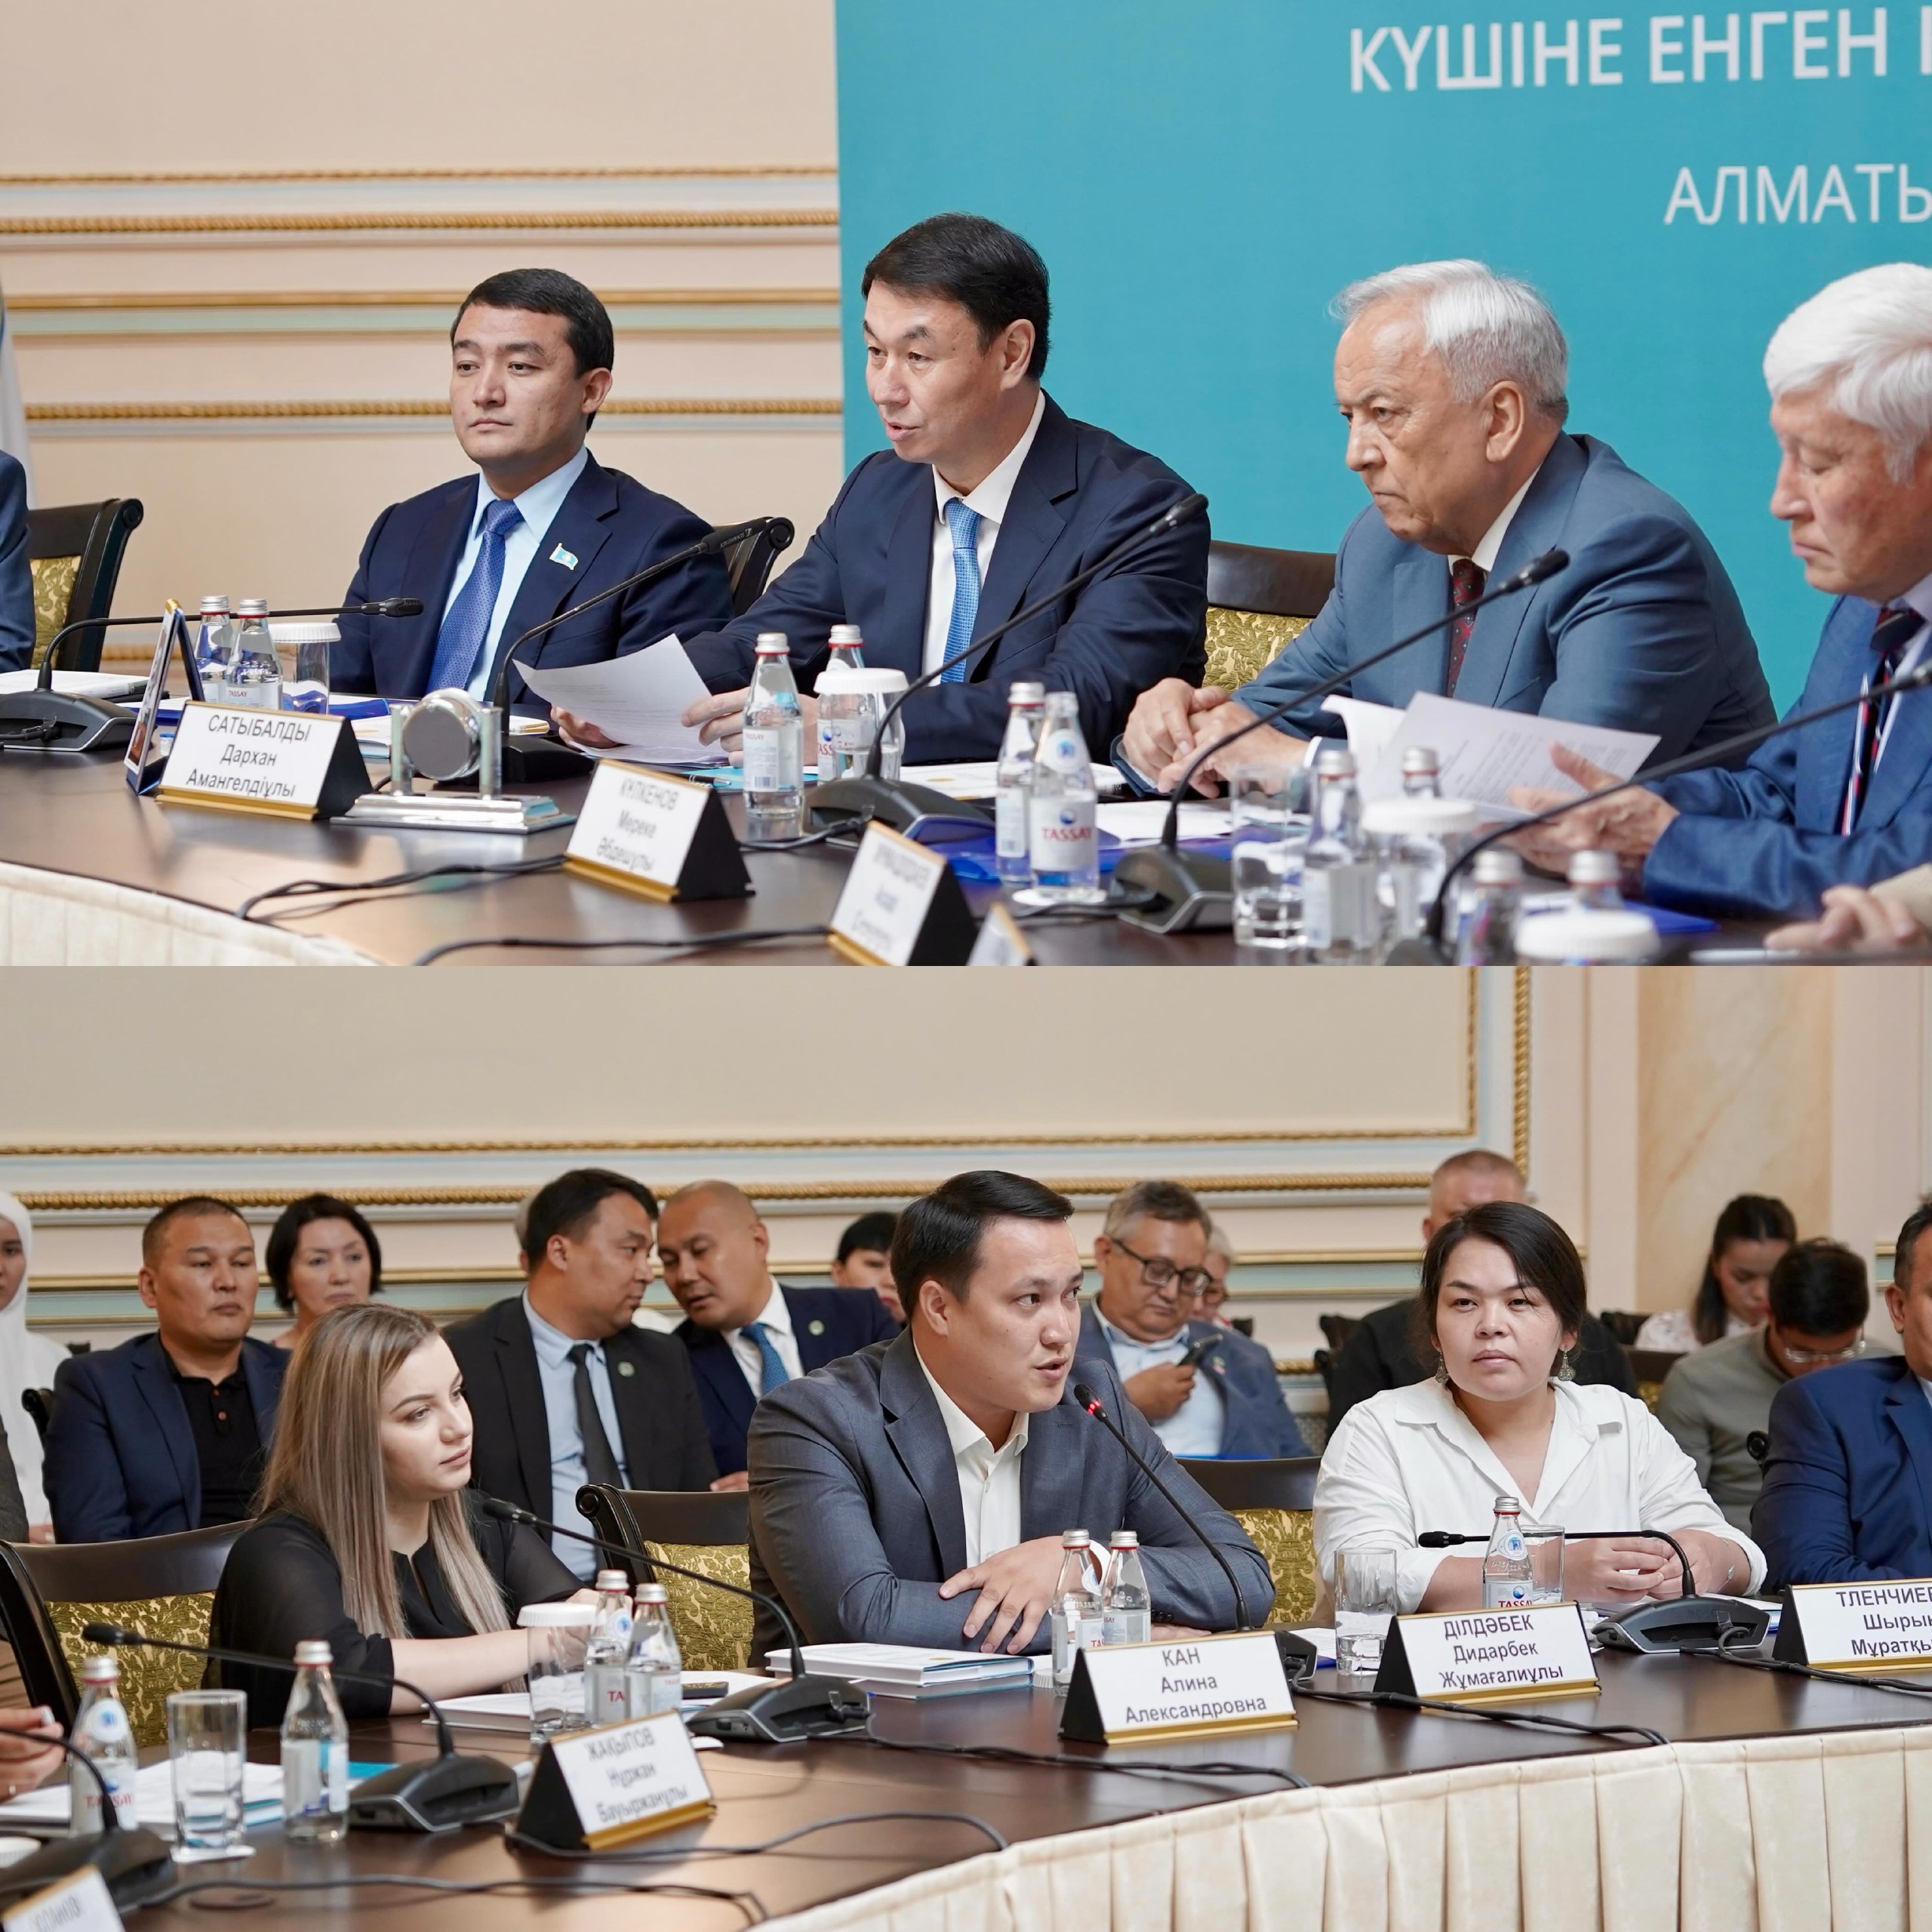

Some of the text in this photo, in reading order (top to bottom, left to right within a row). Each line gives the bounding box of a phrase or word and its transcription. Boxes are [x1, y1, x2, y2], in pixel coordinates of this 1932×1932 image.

[1351, 18, 1623, 92] КҮШІНЕ
[1651, 8, 1887, 83] ЕНГЕН
[208, 714, 312, 743] САТЫБАЛДЫ
[220, 743, 277, 767] Дархан
[186, 768, 297, 798] Амангелдіұлы
[1444, 1614, 1534, 1641] ДІЛДӘБЕК
[1162, 1647, 1201, 1667] КАН
[1454, 1641, 1539, 1665] Дидарбек
[1161, 1676, 1218, 1694] Алина
[1439, 1666, 1563, 1690] Жұмағалиұлы
[1126, 1697, 1267, 1724] Александровна
